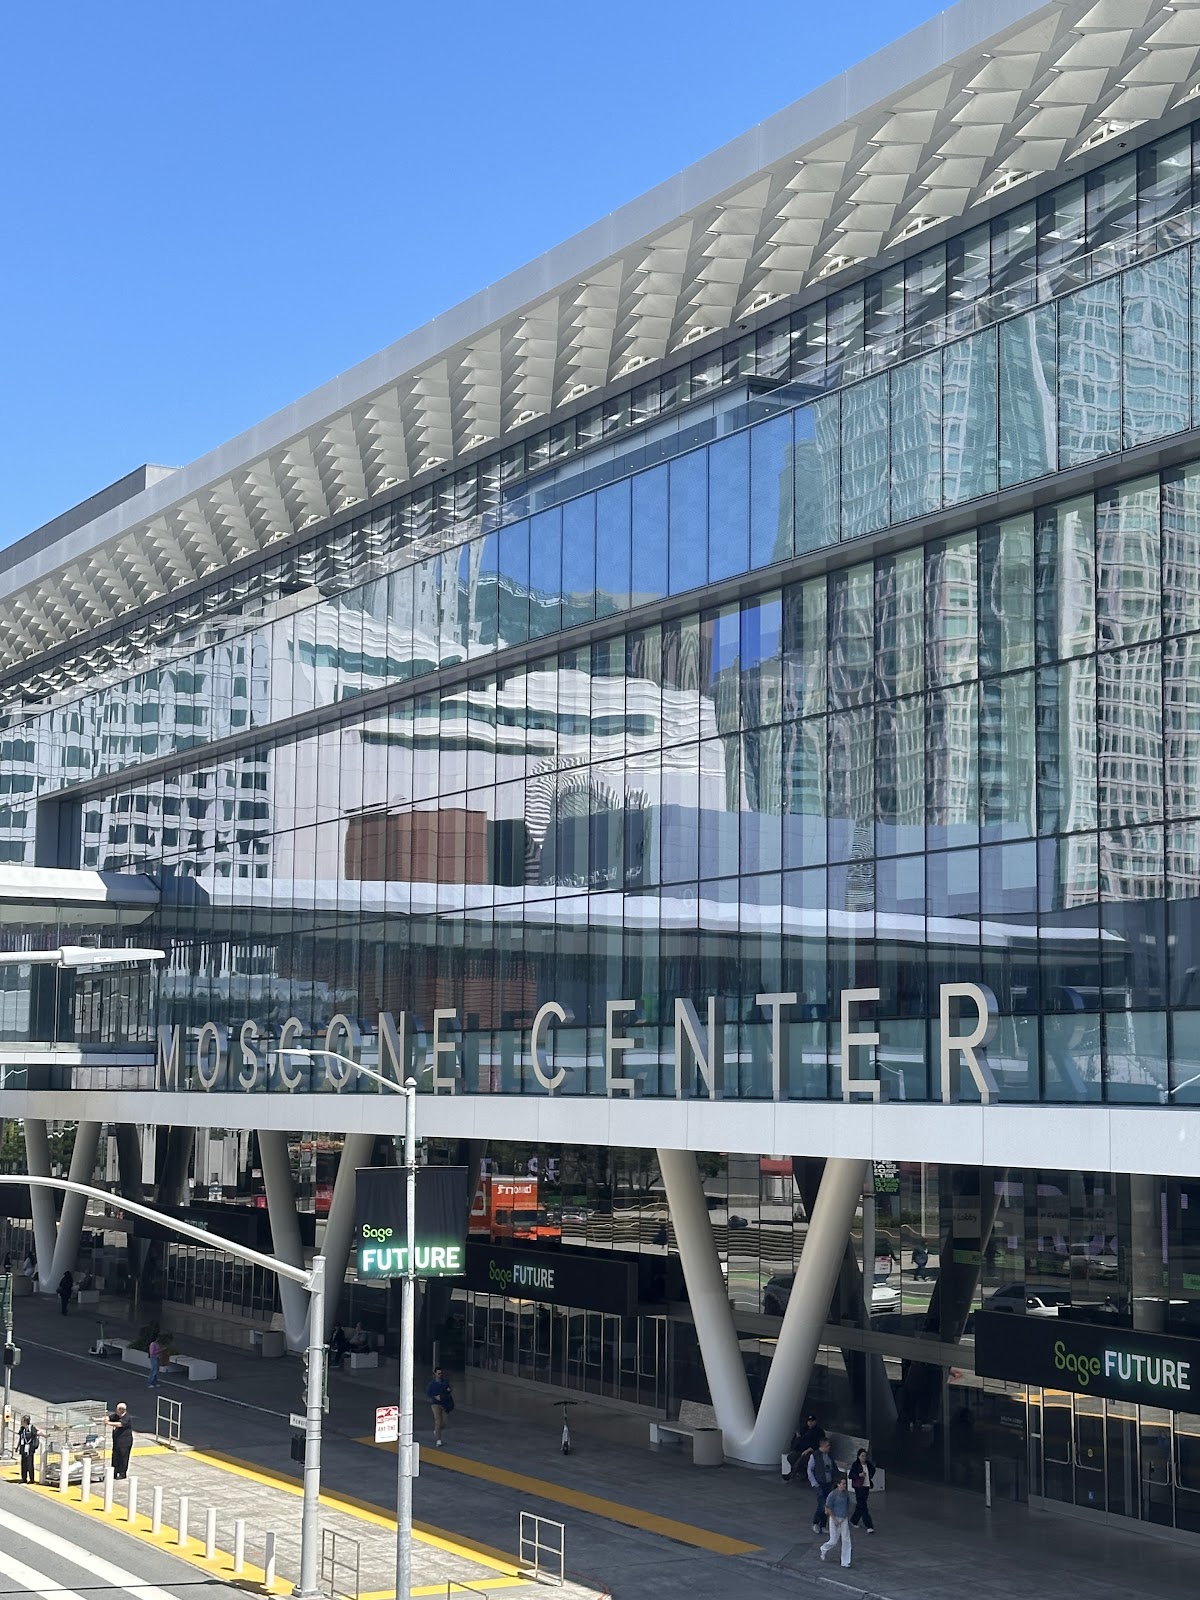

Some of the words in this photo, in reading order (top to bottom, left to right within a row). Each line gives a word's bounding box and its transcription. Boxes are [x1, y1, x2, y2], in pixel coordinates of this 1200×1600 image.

[157, 1008, 458, 1092] MOSCONE
[530, 982, 991, 1096] CENTER
[362, 1223, 393, 1243] Sage
[362, 1246, 461, 1272] FUTURE
[489, 1259, 512, 1290] Sage
[513, 1264, 555, 1289] FUTURE
[1054, 1340, 1101, 1386] Sage
[1104, 1350, 1191, 1391] FUTURE
